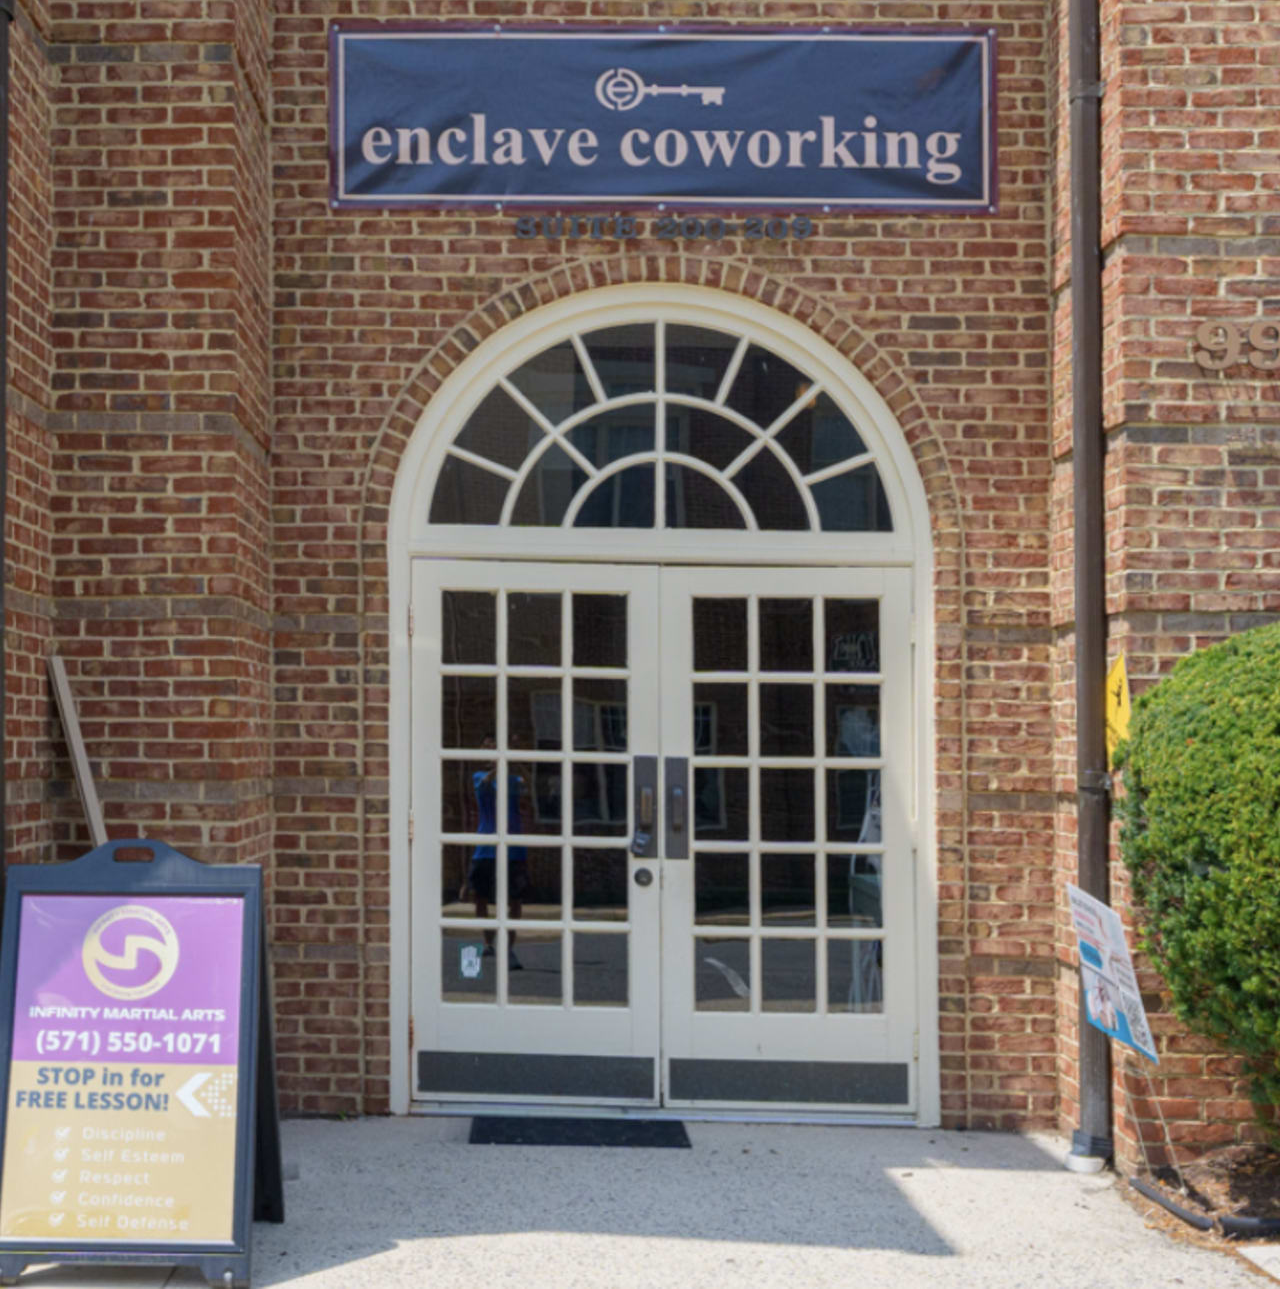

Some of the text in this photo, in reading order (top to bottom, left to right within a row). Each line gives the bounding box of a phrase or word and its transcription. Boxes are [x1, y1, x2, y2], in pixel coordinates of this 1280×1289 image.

[361, 113, 962, 186] enclave coworking
[515, 216, 813, 240] SUITE 200-209
[29, 1006, 226, 1022] INFINITY MARTIAL ARTS
[36, 1030, 221, 1055] (571) 550-1071
[37, 1067, 165, 1087] STOP in for
[16, 1091, 169, 1111] FREE LESSON!
[82, 1127, 166, 1142] Discipline
[81, 1148, 185, 1163] Self Esteem
[80, 1169, 150, 1185] Respect
[78, 1191, 175, 1207] Confidence
[77, 1214, 189, 1230] Self Defense
